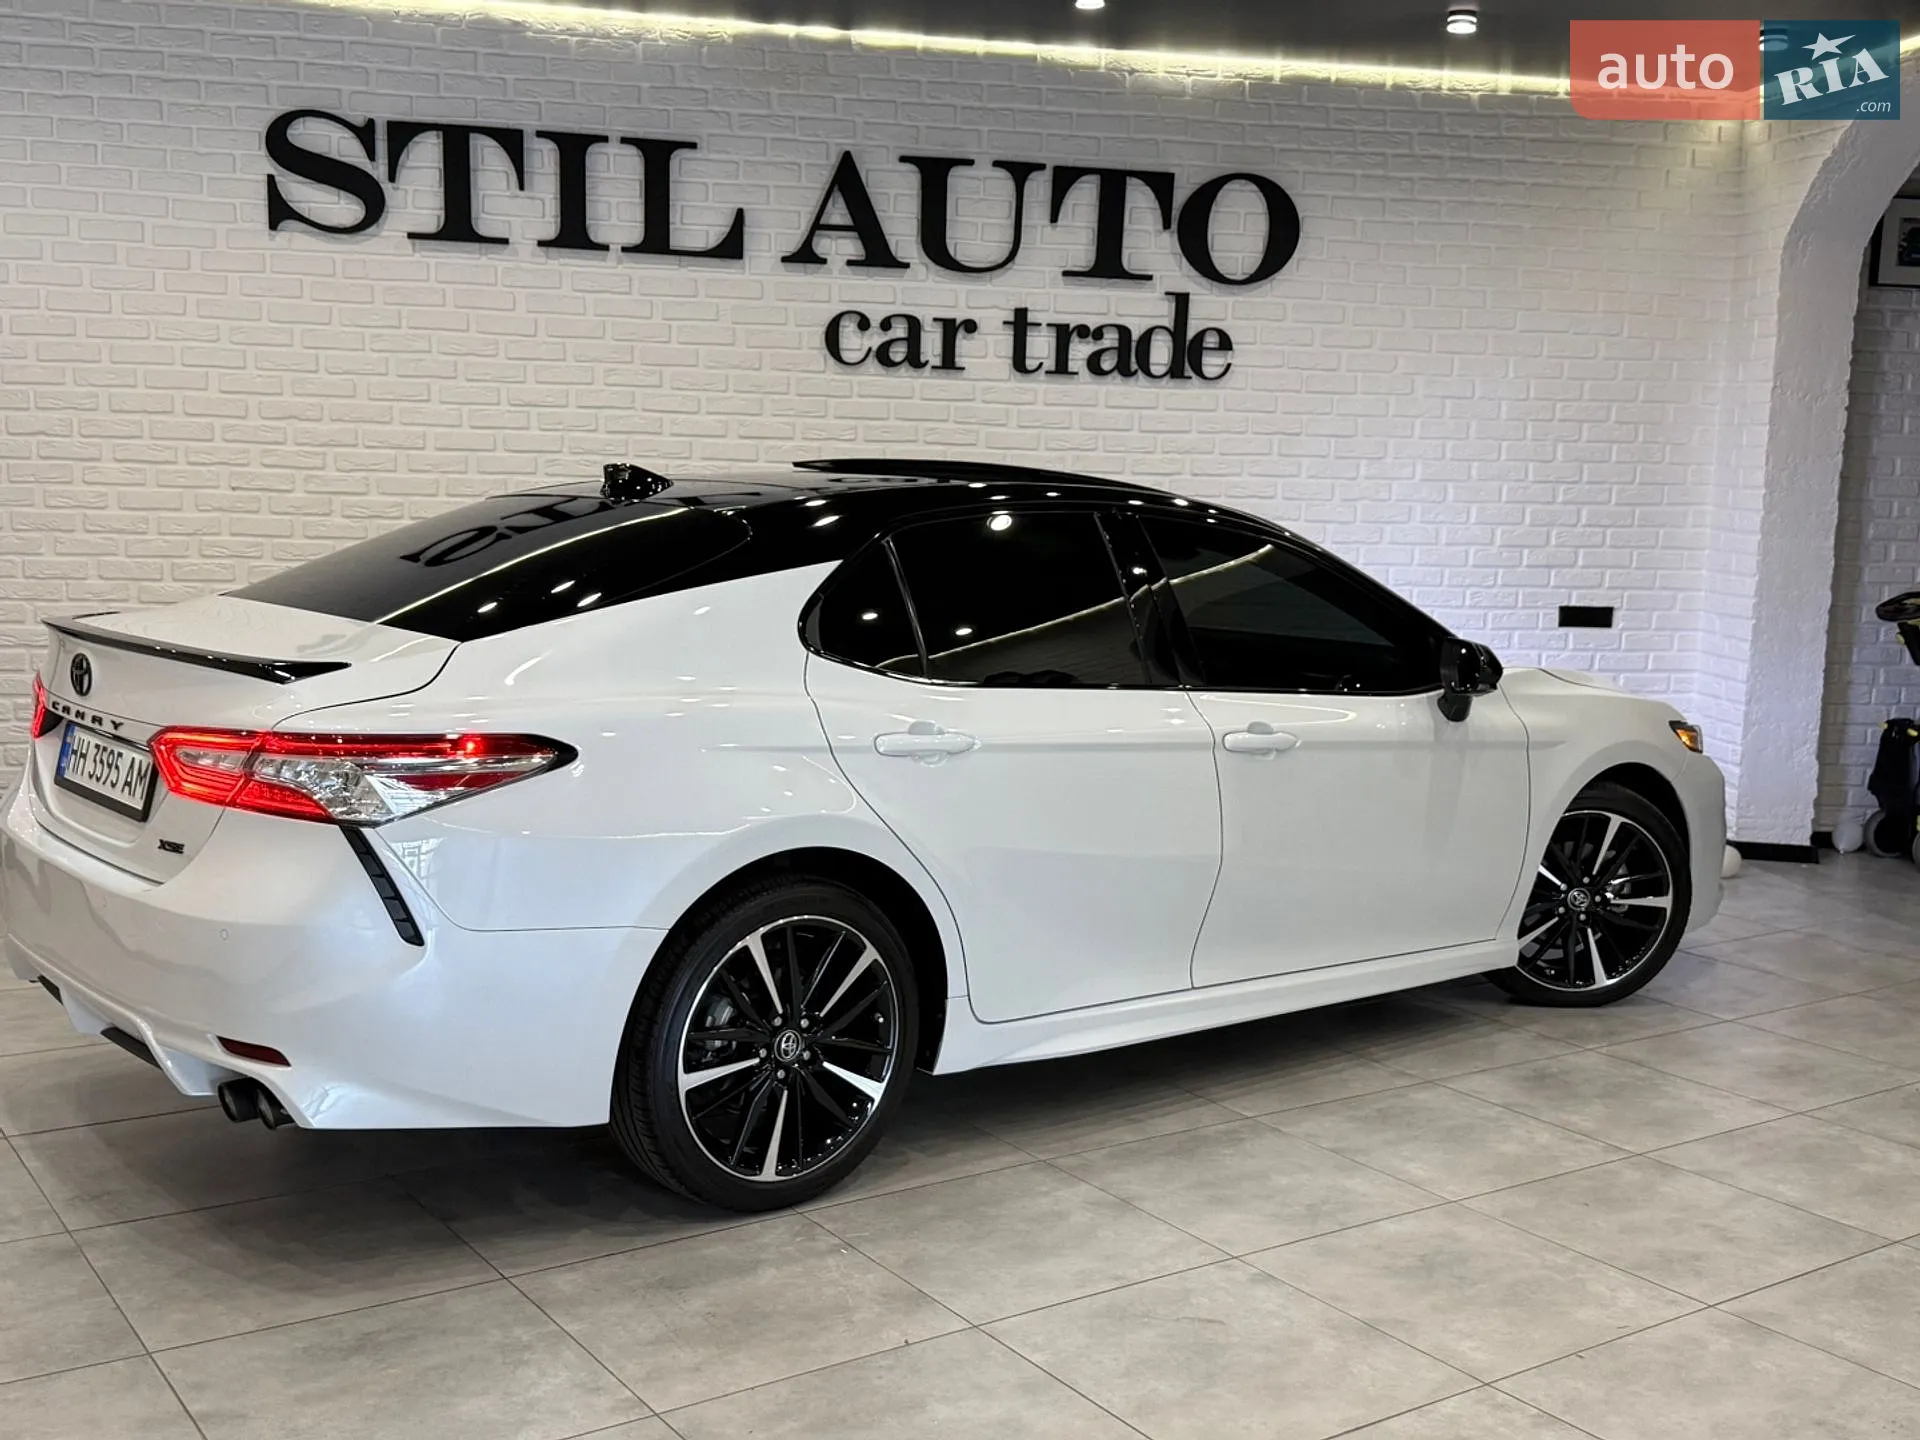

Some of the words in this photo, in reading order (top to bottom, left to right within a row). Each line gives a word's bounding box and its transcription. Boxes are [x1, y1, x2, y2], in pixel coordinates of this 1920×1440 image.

[266, 109, 745, 260] STIL
[780, 150, 1301, 286] AUTO
[824, 310, 978, 376] car
[1002, 291, 1233, 382] trade
[88, 742, 124, 789] 3595
[122, 757, 151, 801] AM
